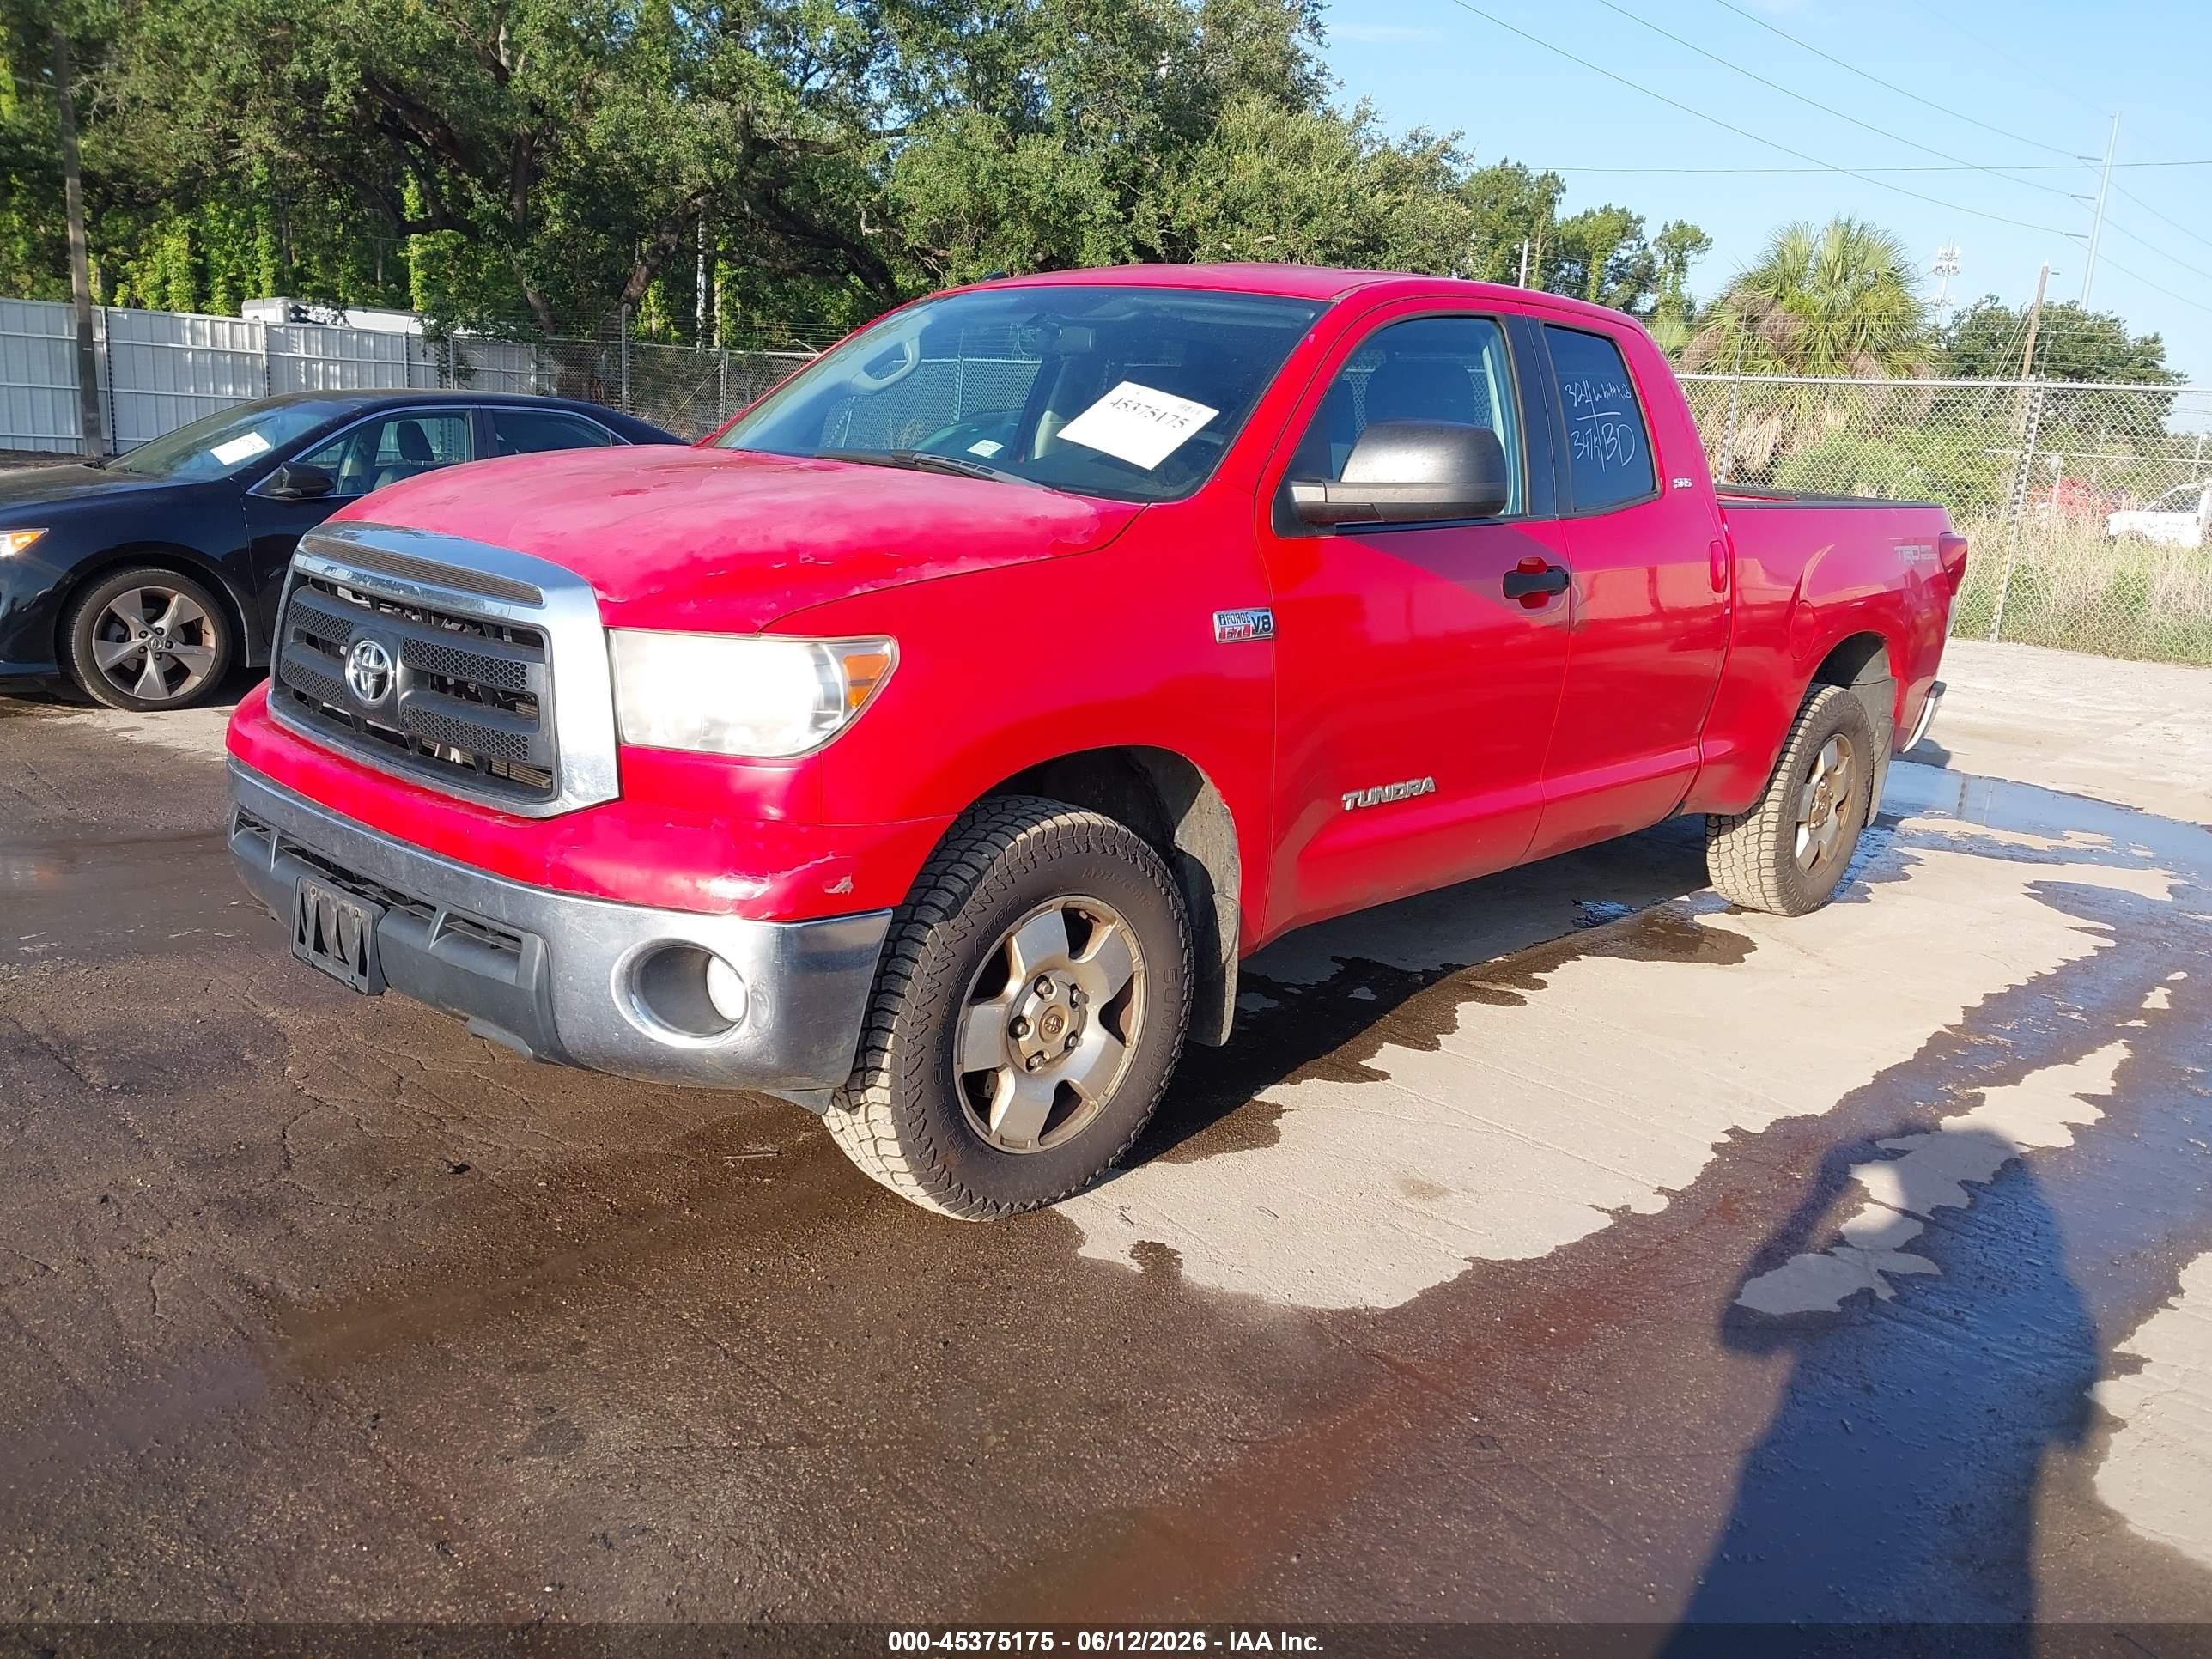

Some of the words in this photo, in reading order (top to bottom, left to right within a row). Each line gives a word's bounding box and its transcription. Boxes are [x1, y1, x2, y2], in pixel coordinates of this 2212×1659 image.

[1110, 398, 1189, 428] 45375175
[1893, 545, 1920, 565] TRD
[1251, 614, 1272, 633] V8
[1342, 776, 1436, 811] TUNDRA
[1143, 968, 1179, 1093] SUMMIT
